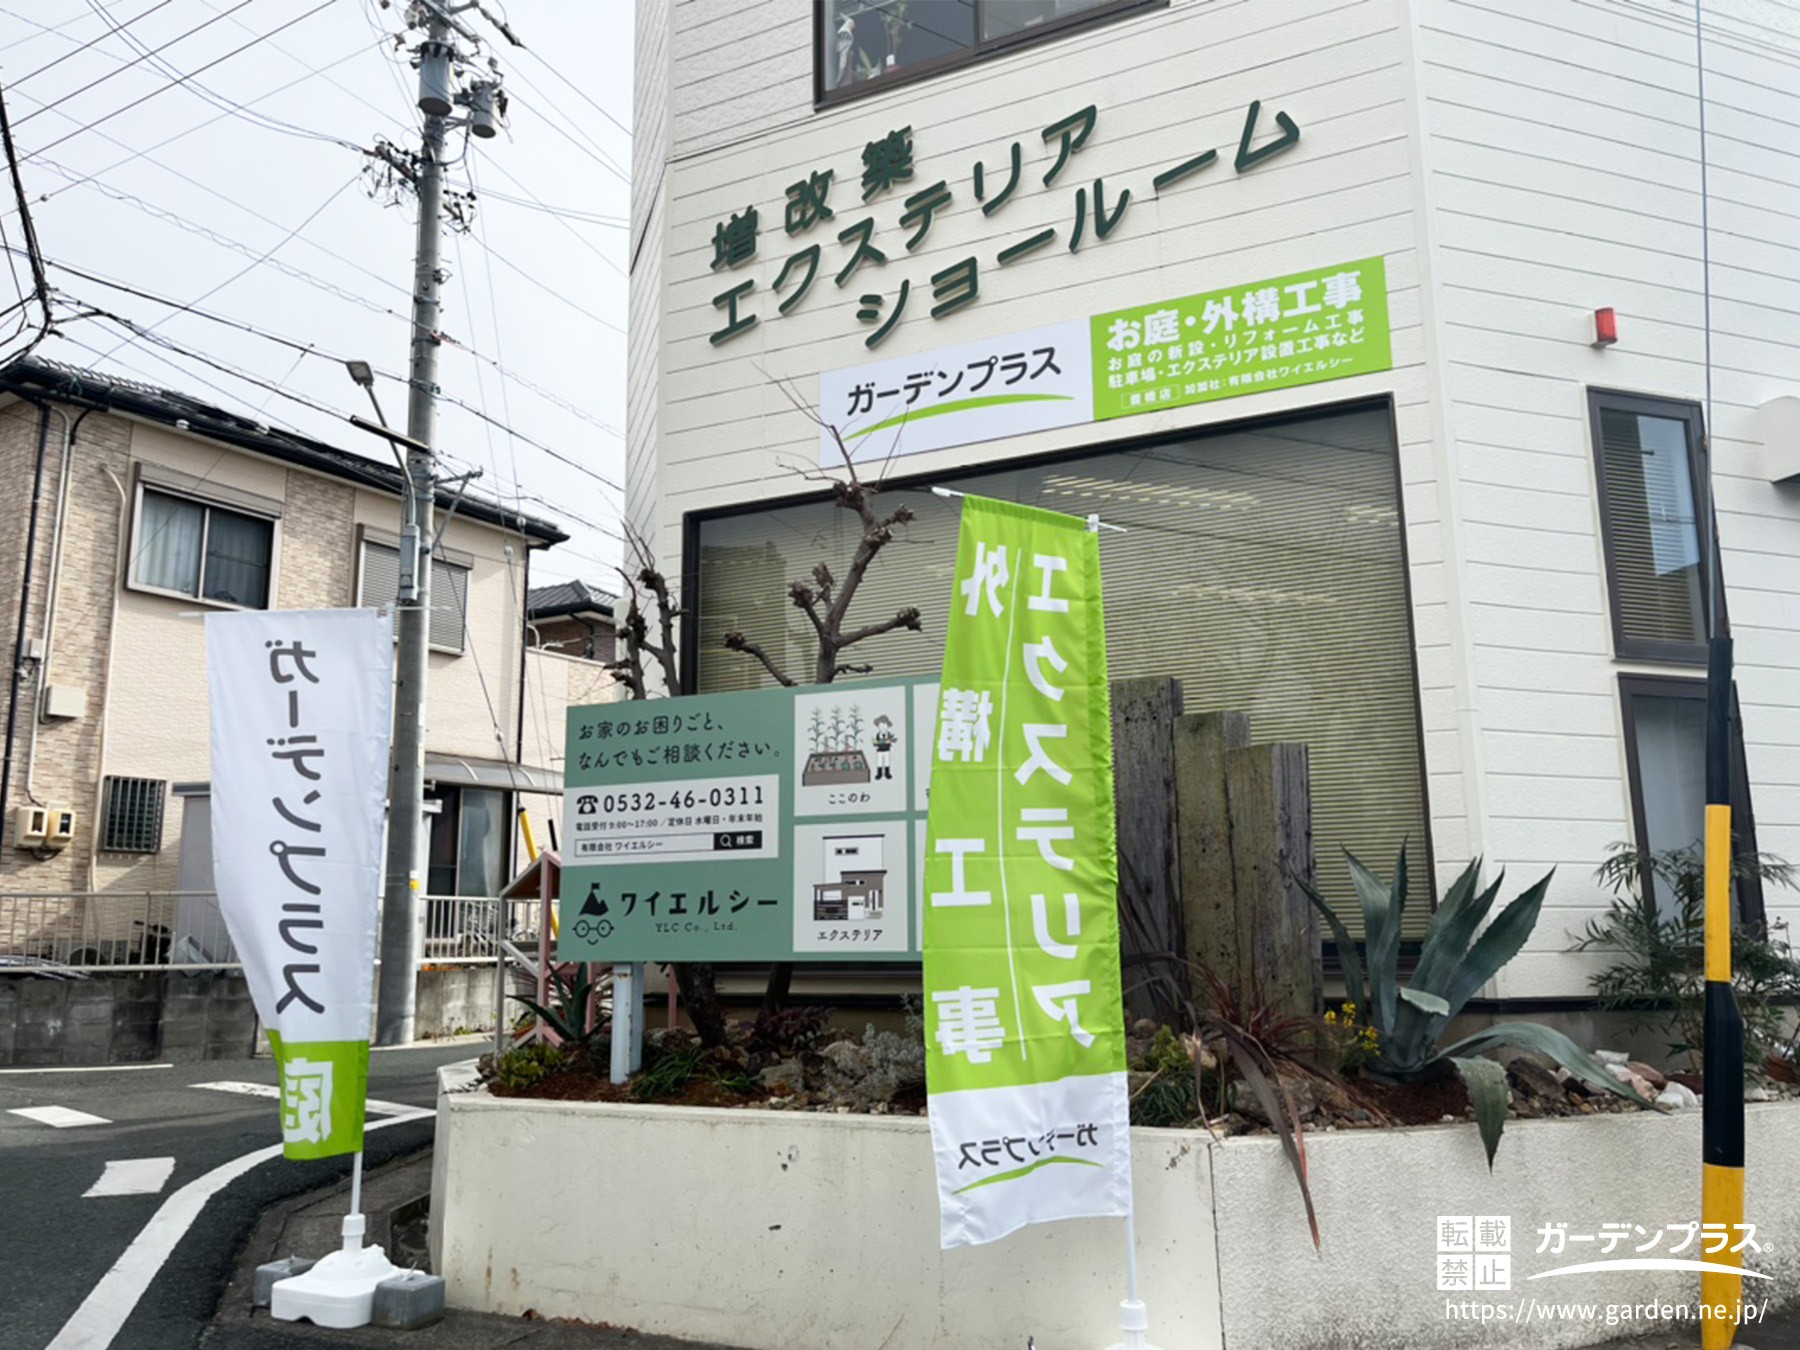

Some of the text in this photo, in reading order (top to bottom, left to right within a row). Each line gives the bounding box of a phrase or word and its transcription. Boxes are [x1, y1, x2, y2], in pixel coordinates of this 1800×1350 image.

[710, 124, 914, 271] 増改築
[709, 104, 1097, 346] エクステリア
[856, 100, 1300, 348] ショールーム
[1107, 270, 1363, 351] お庭・外構工事
[1108, 309, 1364, 371] お庭の新設・リフォーム工事
[1108, 327, 1365, 388] 駐車場・エクステリア設置工事など
[846, 346, 1062, 417] ガーデンプラス
[578, 712, 724, 740] お家のお困りごと、
[578, 741, 780, 770] なんでもご相談ください。
[603, 786, 764, 813] 0532-46-0311
[828, 792, 871, 805] ここのわ
[615, 840, 663, 850] ワイエルシー
[620, 890, 778, 916] ワイエルシー
[655, 922, 679, 933] YLC
[714, 921, 738, 932] Ltd.
[817, 929, 883, 942] エクステリア
